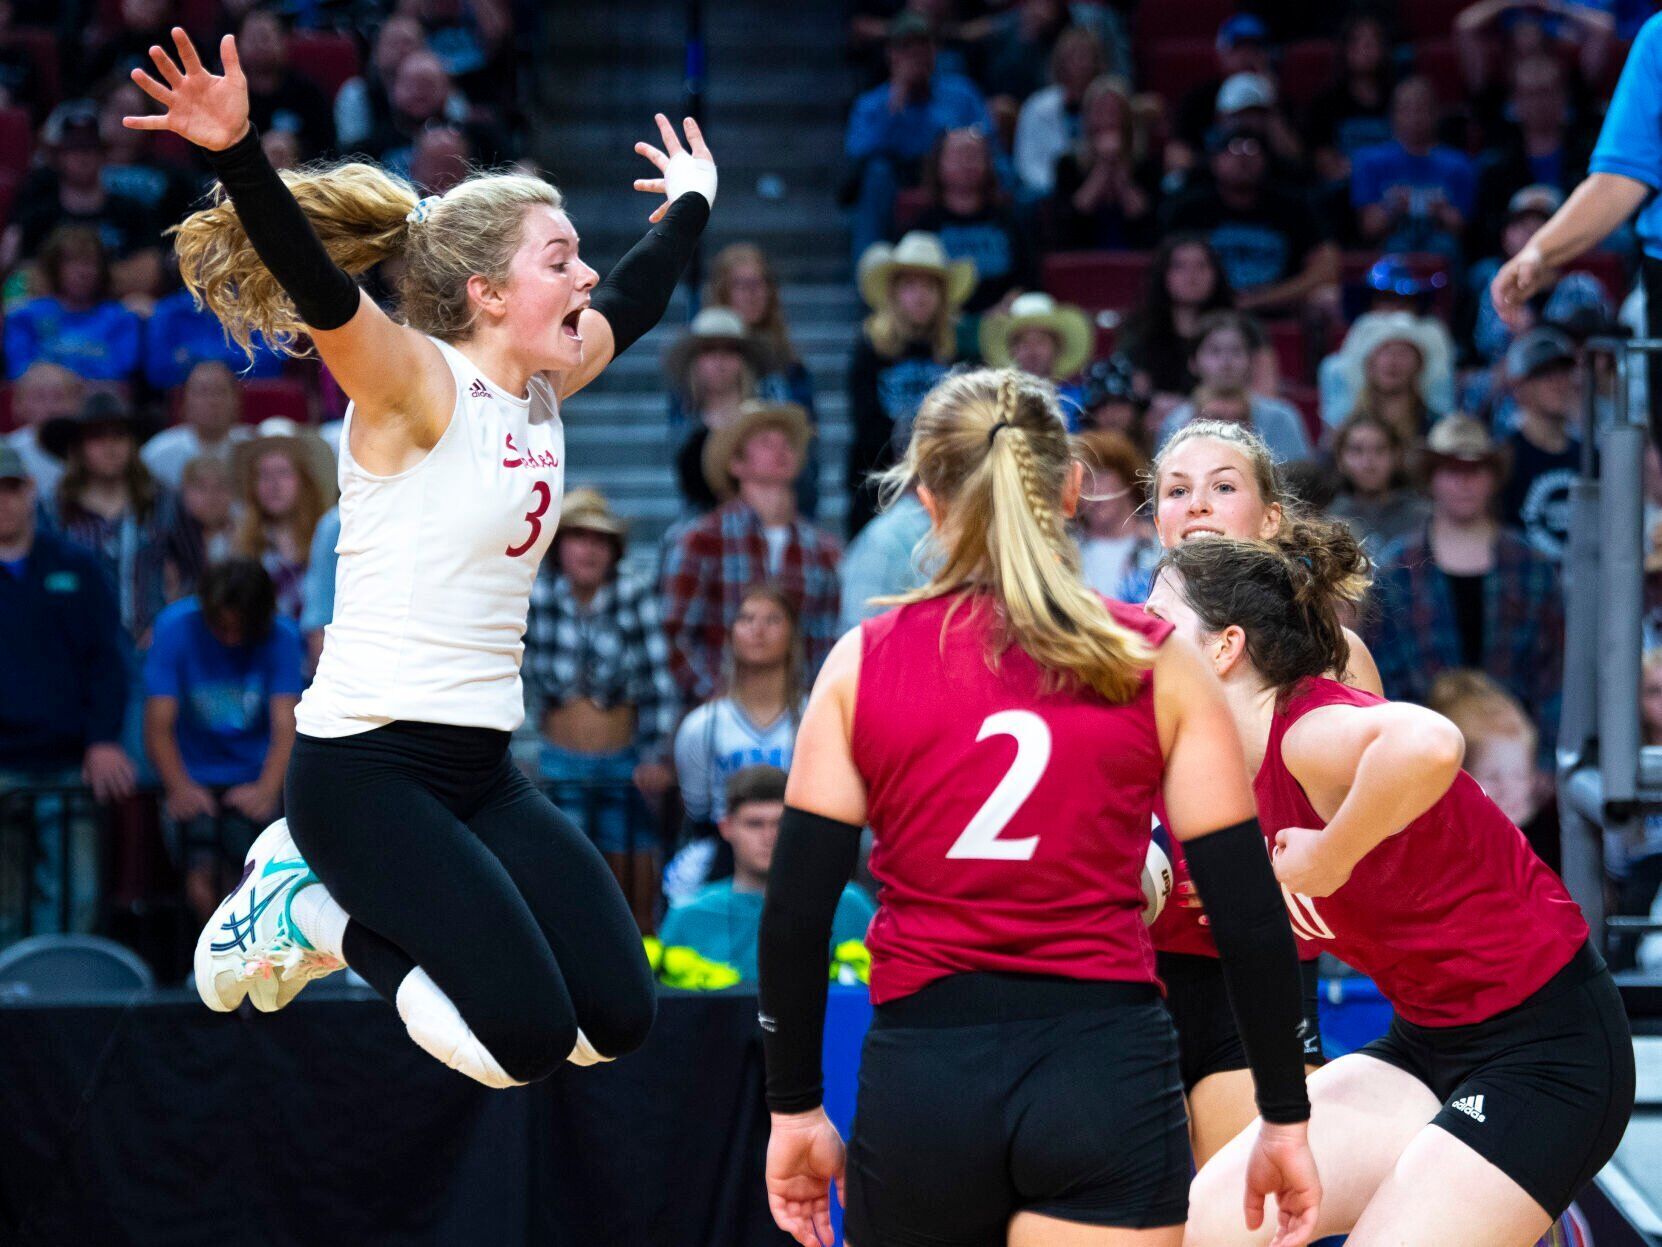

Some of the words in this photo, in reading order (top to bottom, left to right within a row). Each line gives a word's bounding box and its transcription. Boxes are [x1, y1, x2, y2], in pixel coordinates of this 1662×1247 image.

[505, 480, 551, 557] 3
[945, 709, 1052, 861] 2
[1451, 1100, 1486, 1123] adidas
